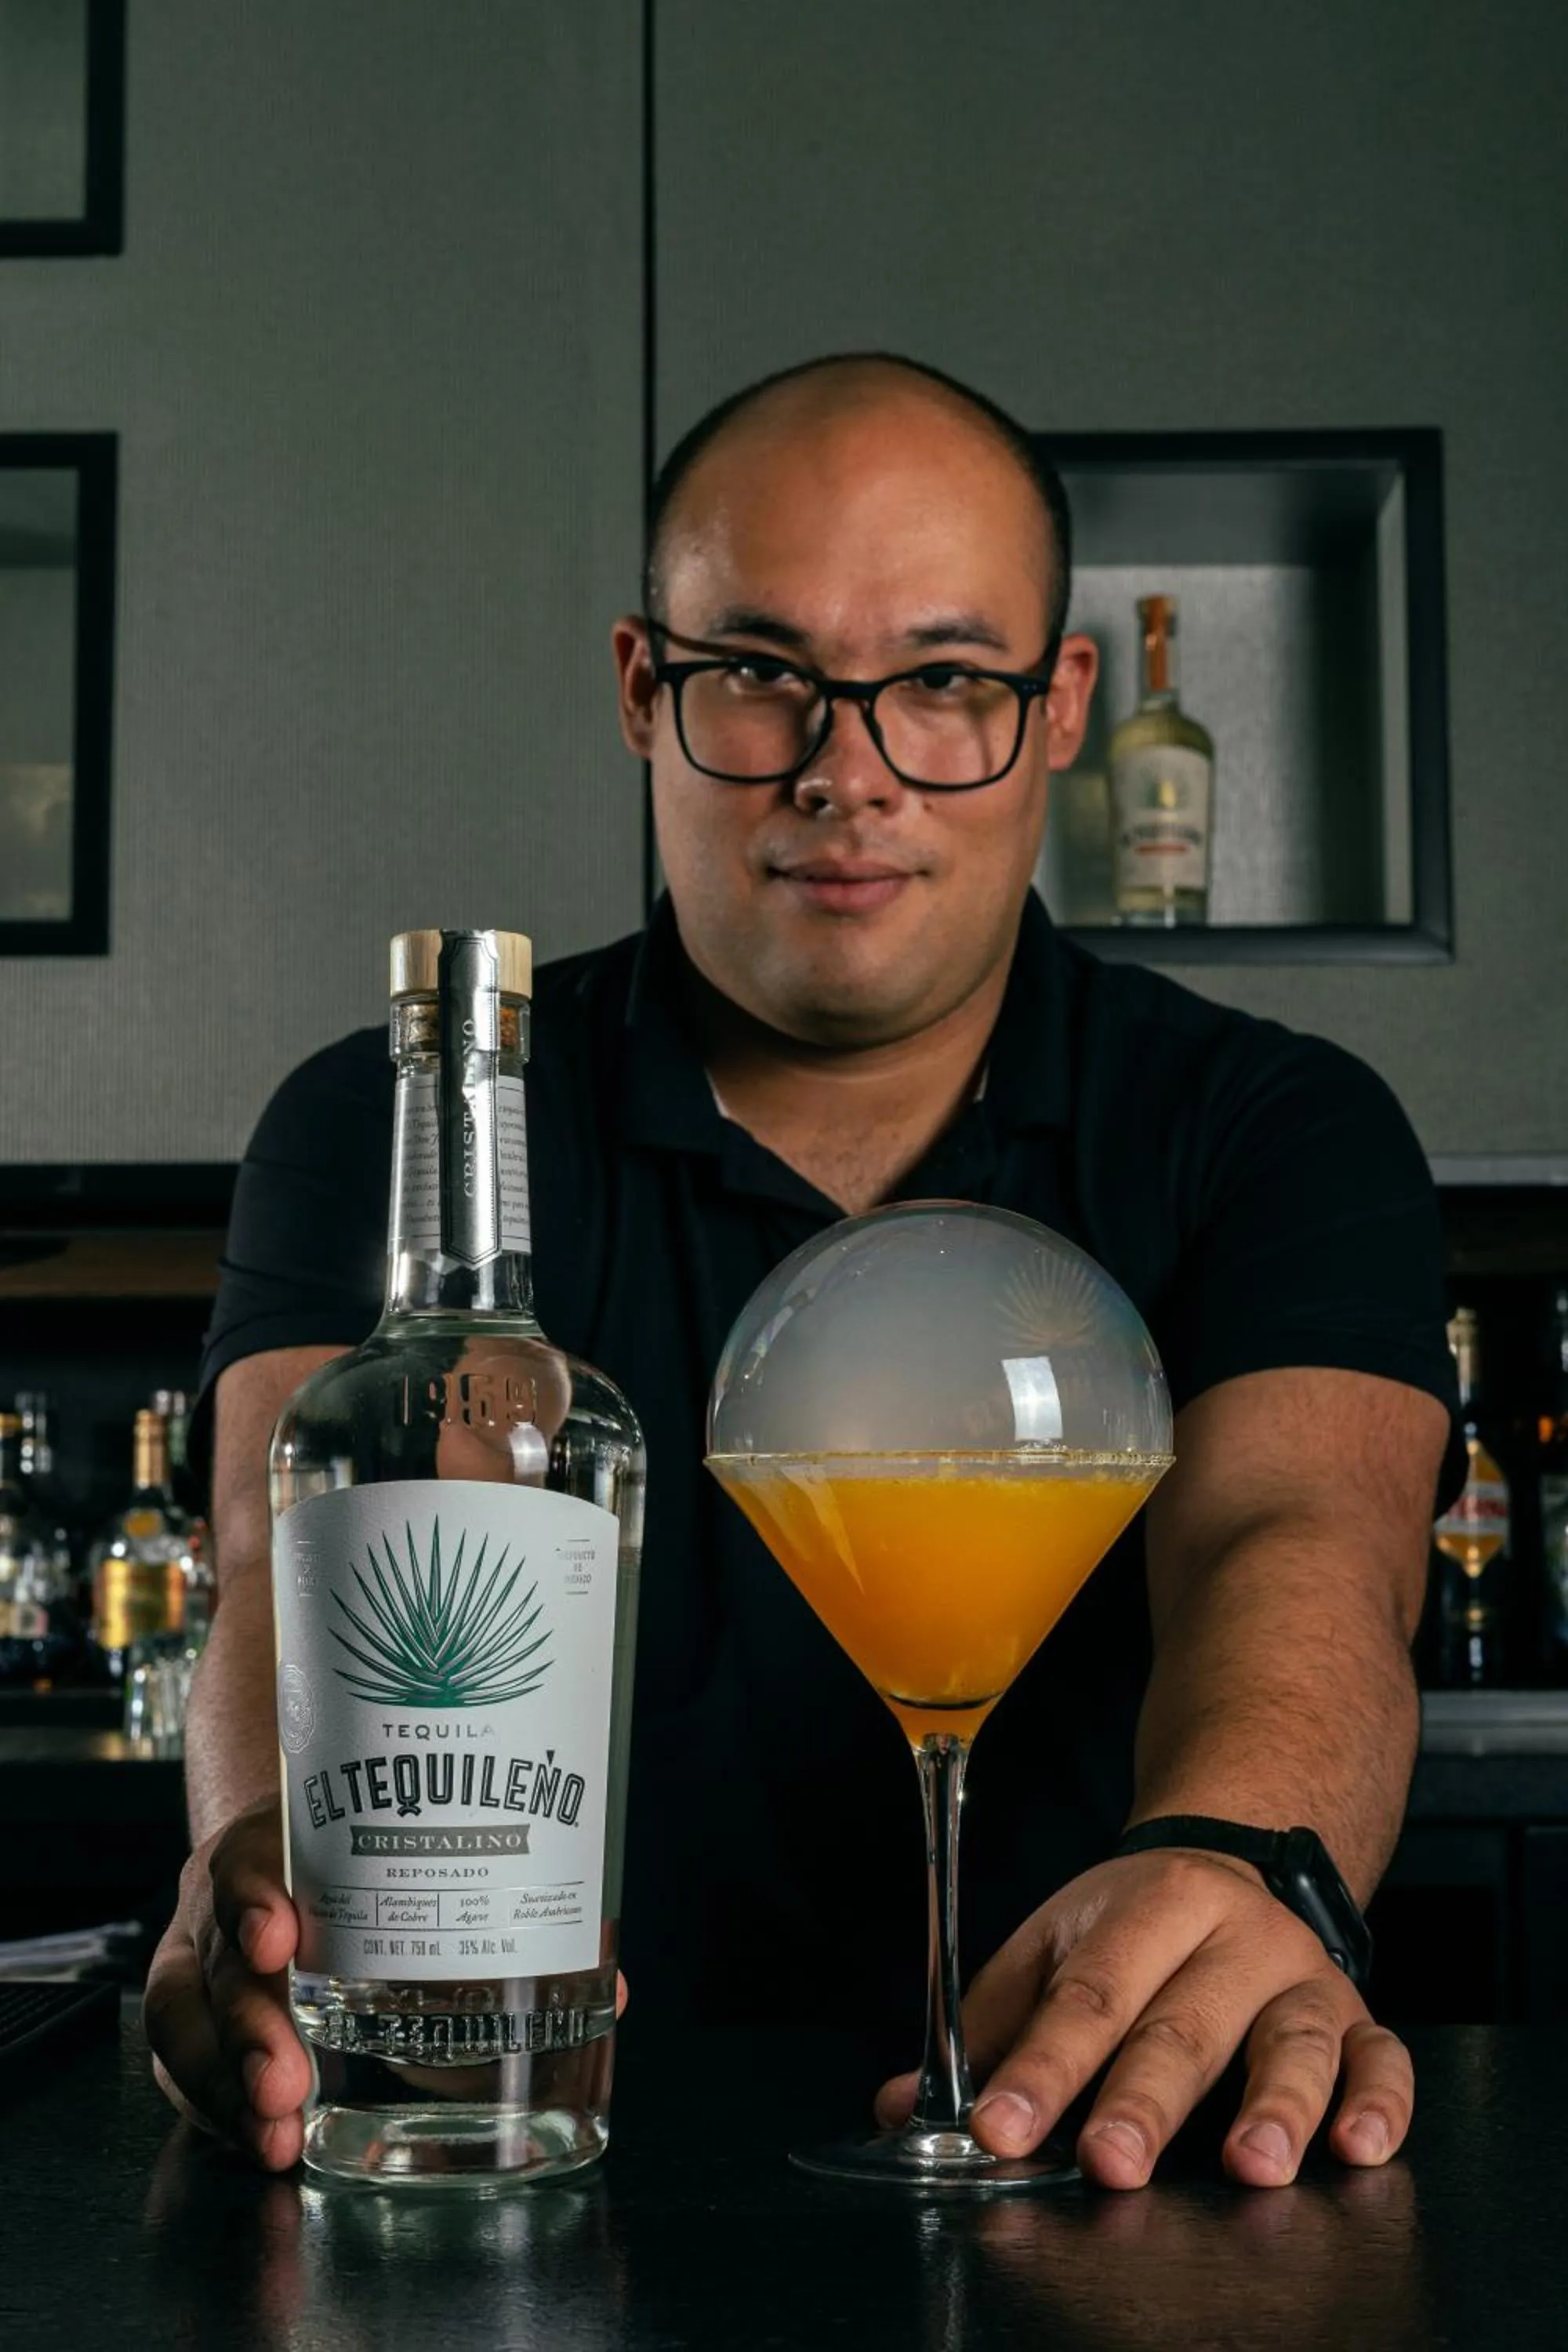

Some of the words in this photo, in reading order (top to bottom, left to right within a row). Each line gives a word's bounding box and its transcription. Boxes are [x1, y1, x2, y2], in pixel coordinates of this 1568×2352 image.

[383, 1723, 495, 1740] TEQUILA
[303, 1770, 346, 1830] EL
[358, 1832, 521, 1850] CRISTALINO
[387, 1867, 489, 1879] REPOSADO
[459, 1894, 490, 1907] 100%
[401, 1911, 429, 1922] Cobre
